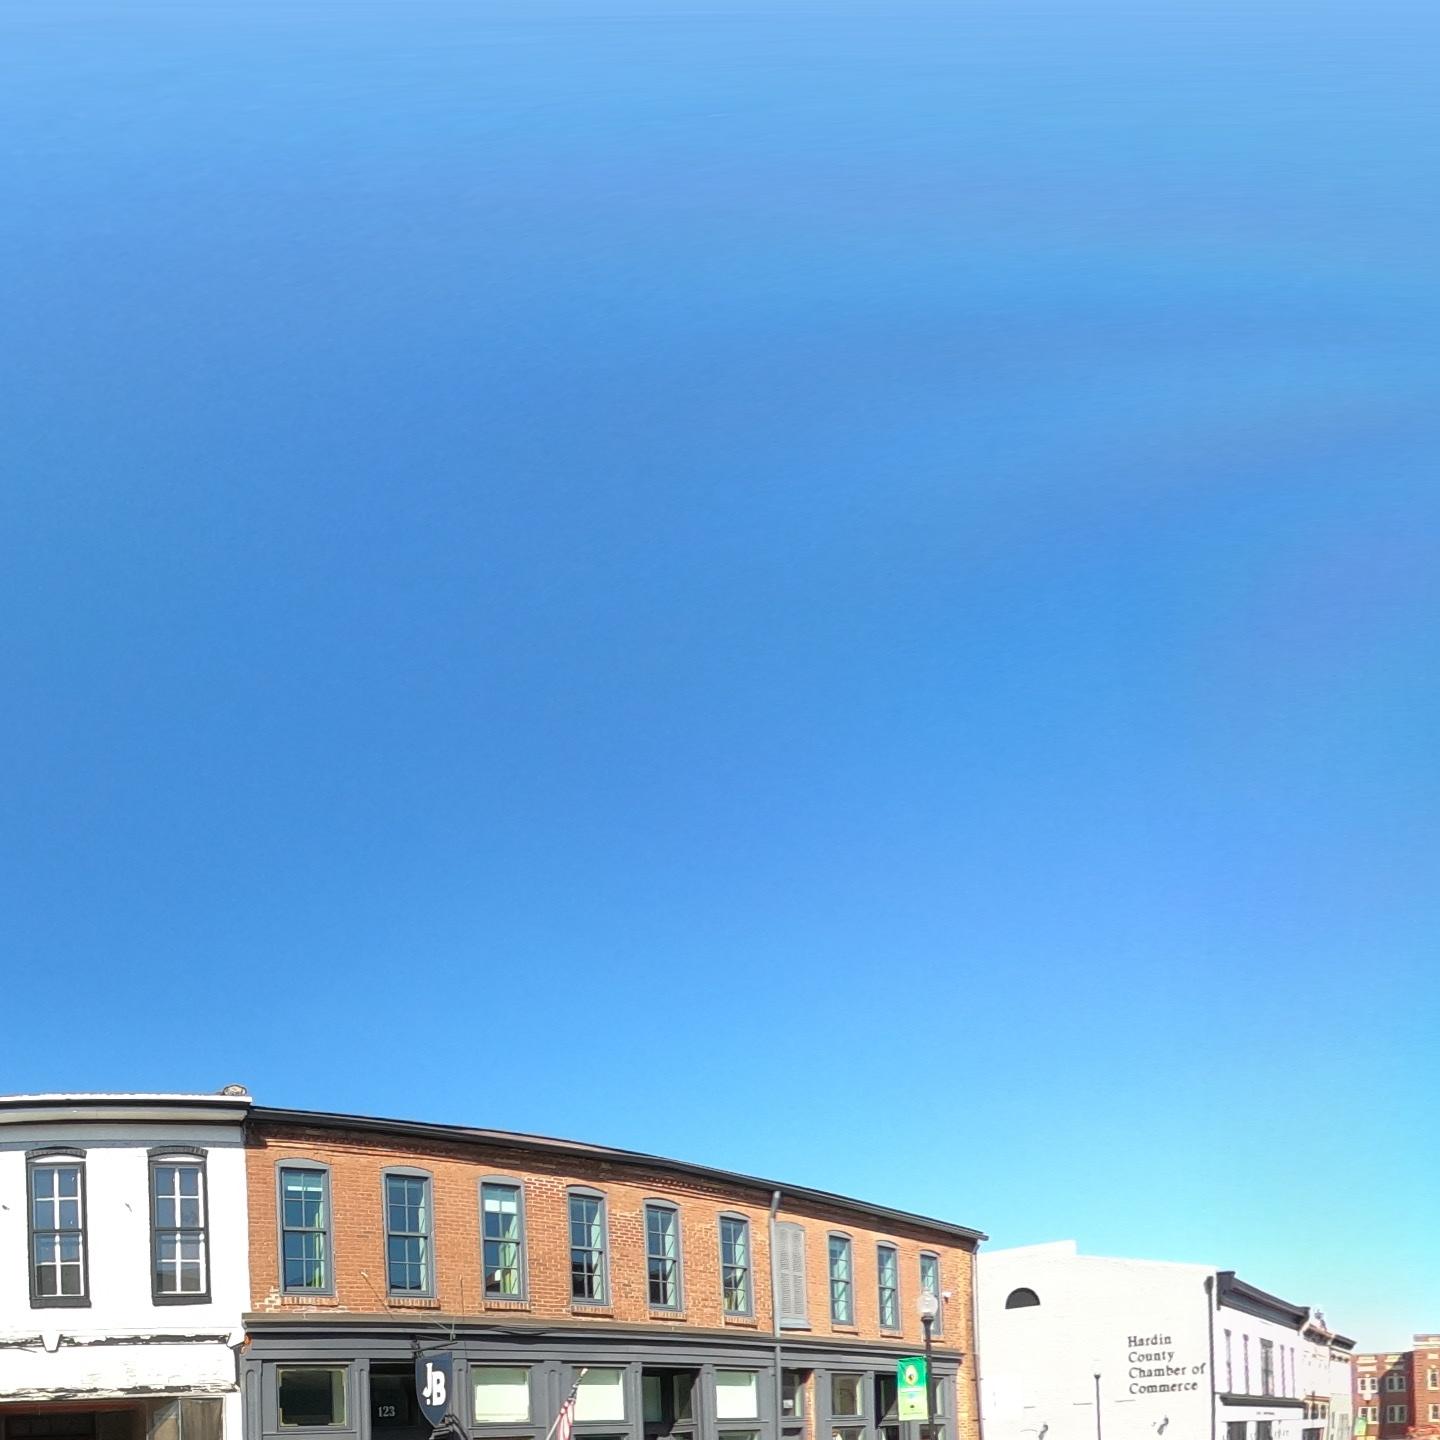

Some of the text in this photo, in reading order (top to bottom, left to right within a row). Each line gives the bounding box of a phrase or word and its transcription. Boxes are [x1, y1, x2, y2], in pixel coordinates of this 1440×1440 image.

[1127, 1334, 1172, 1348] Hardin
[1128, 1351, 1175, 1363] County
[1128, 1362, 1206, 1379] Chamber of
[1129, 1382, 1198, 1395] Commerce
[378, 1405, 396, 1417] 123
